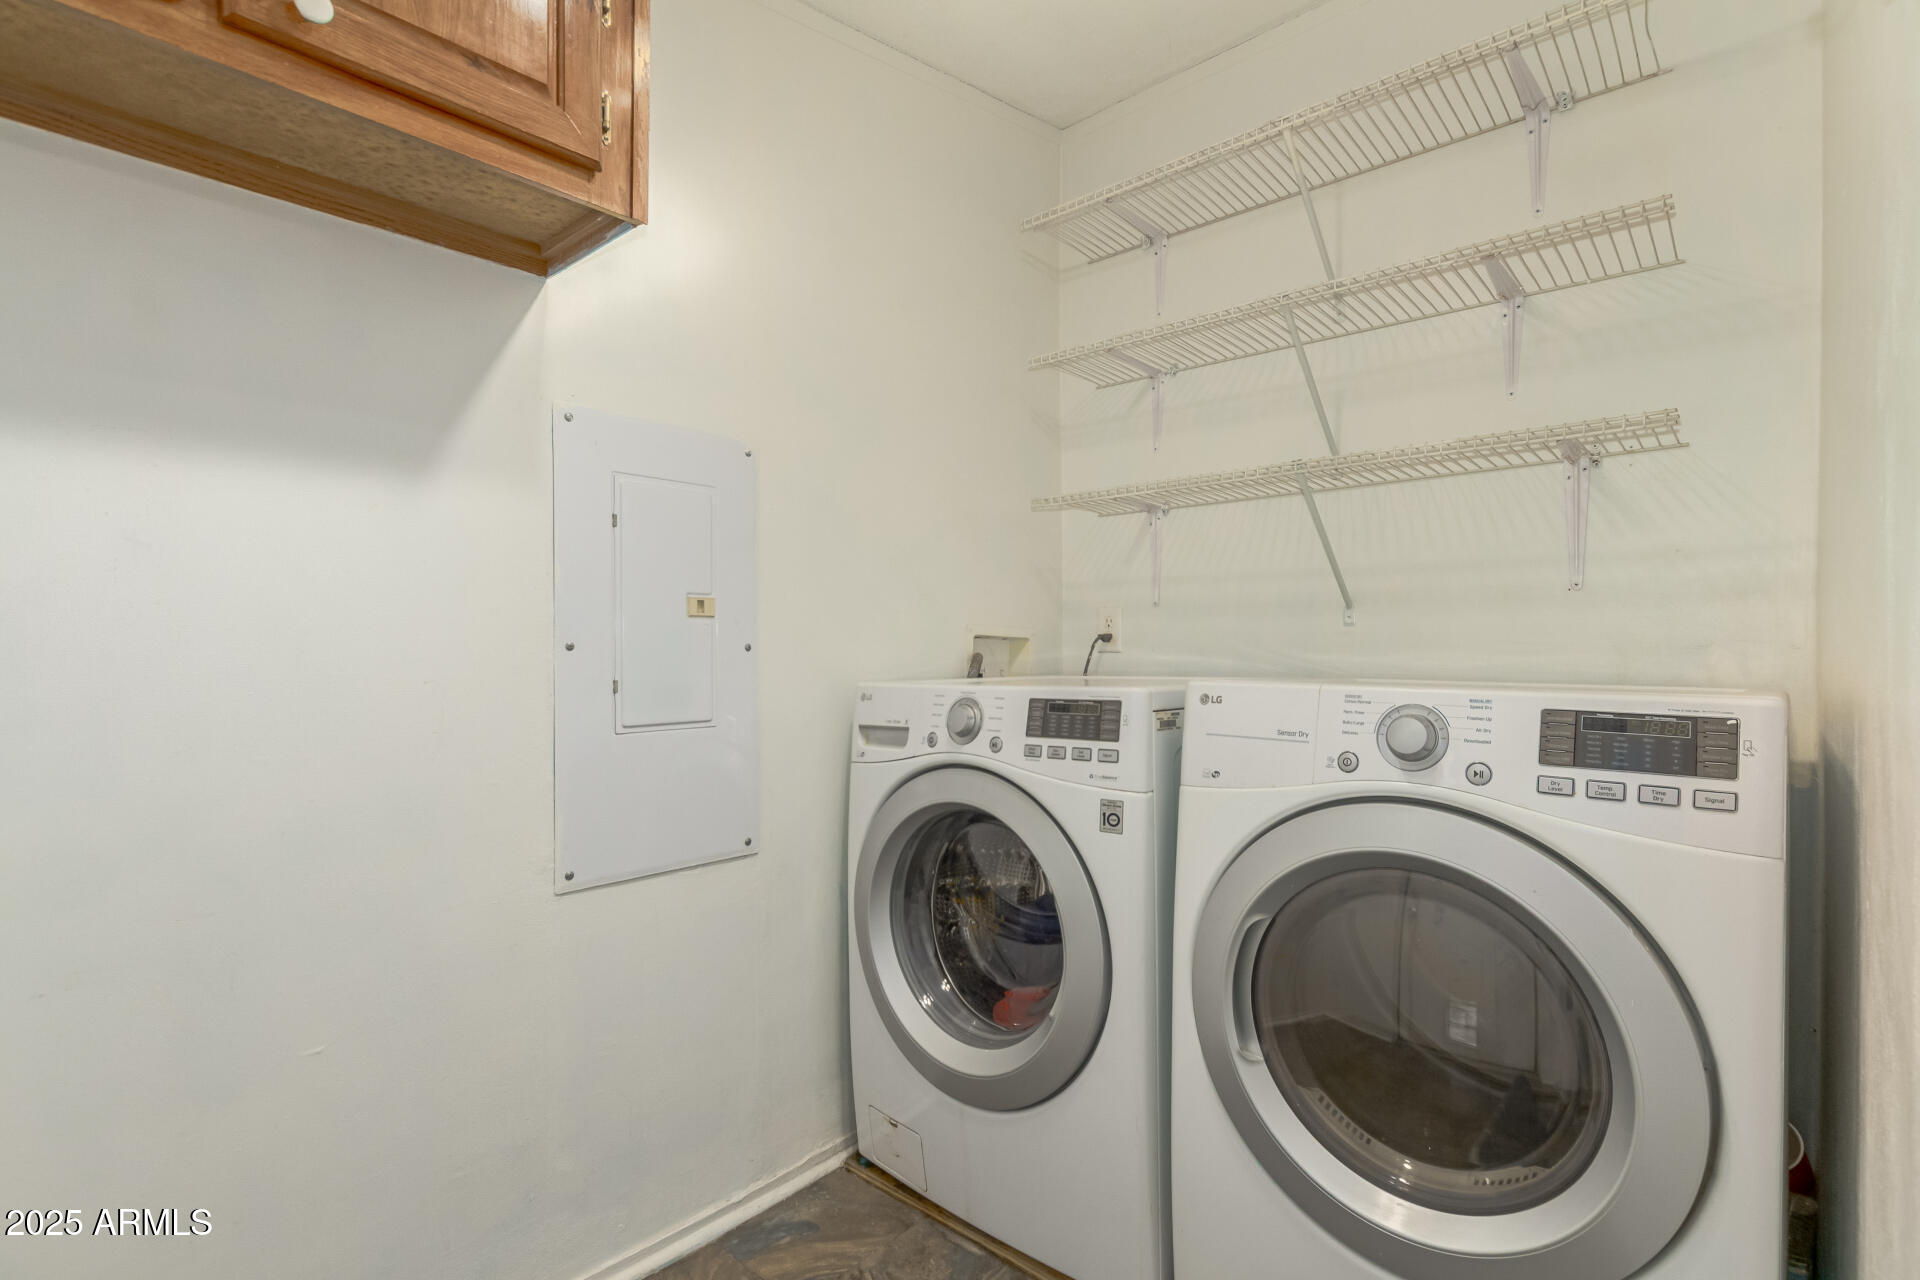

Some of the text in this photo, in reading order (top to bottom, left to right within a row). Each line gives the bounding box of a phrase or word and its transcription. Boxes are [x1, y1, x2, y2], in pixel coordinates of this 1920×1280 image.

[1277, 729, 1309, 739] Sensor Dry
[1594, 790, 1617, 798] Control
[1651, 789, 1667, 797] Time
[1704, 796, 1725, 804] Signal
